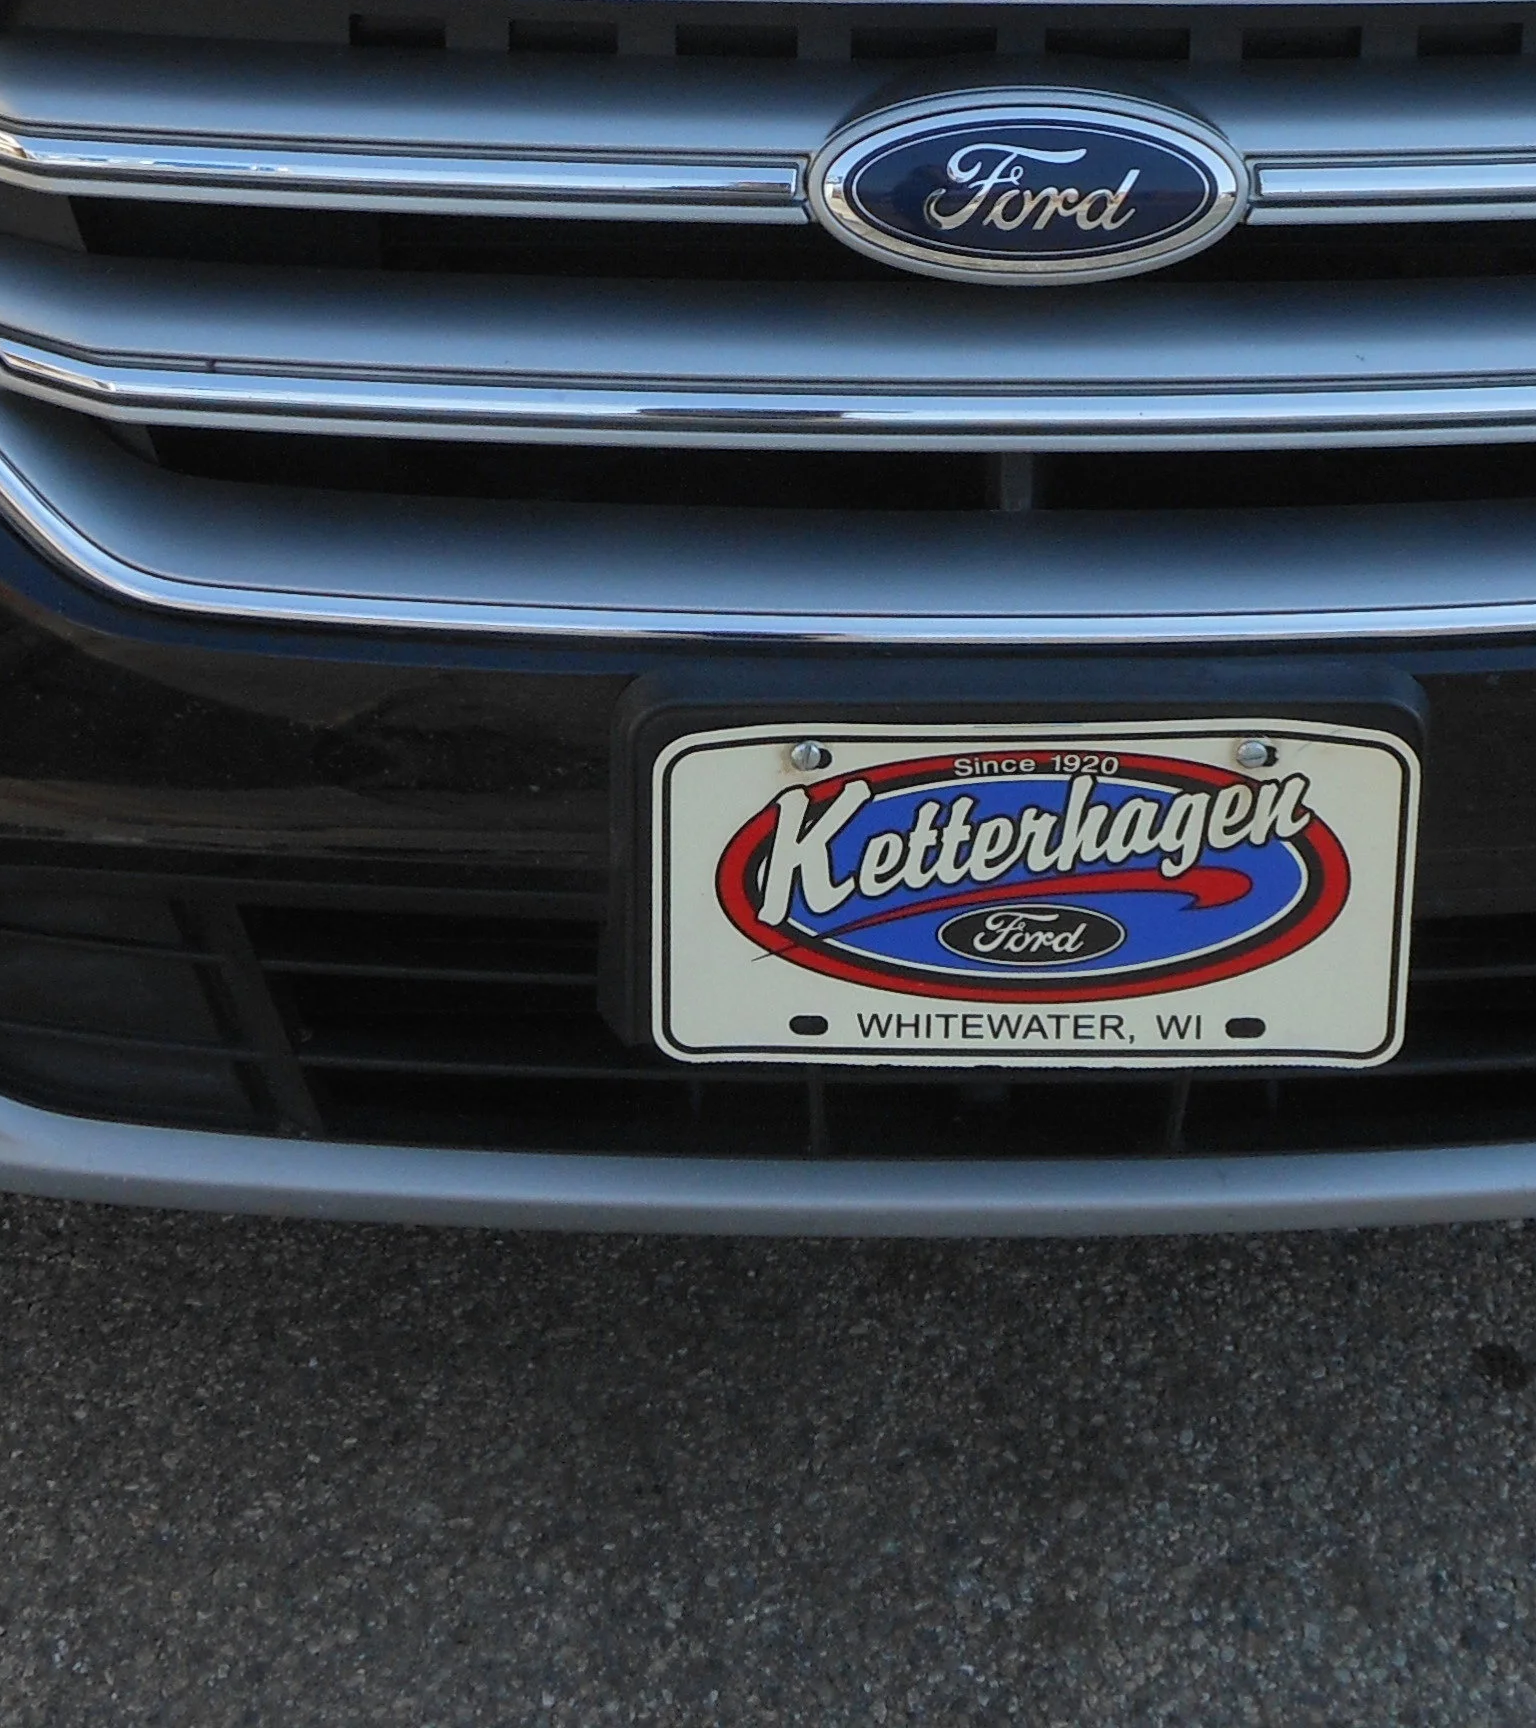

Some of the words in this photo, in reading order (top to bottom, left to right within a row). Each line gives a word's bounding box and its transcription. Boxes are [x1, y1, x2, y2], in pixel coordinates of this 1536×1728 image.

[922, 142, 1141, 232] Ford
[953, 753, 1036, 778] Since
[1050, 753, 1120, 776] 1920
[756, 773, 1313, 926] Ketterhagen
[971, 910, 1085, 955] Ford
[856, 1012, 1137, 1045] WHITEWATER,
[1155, 1013, 1204, 1041] WI
